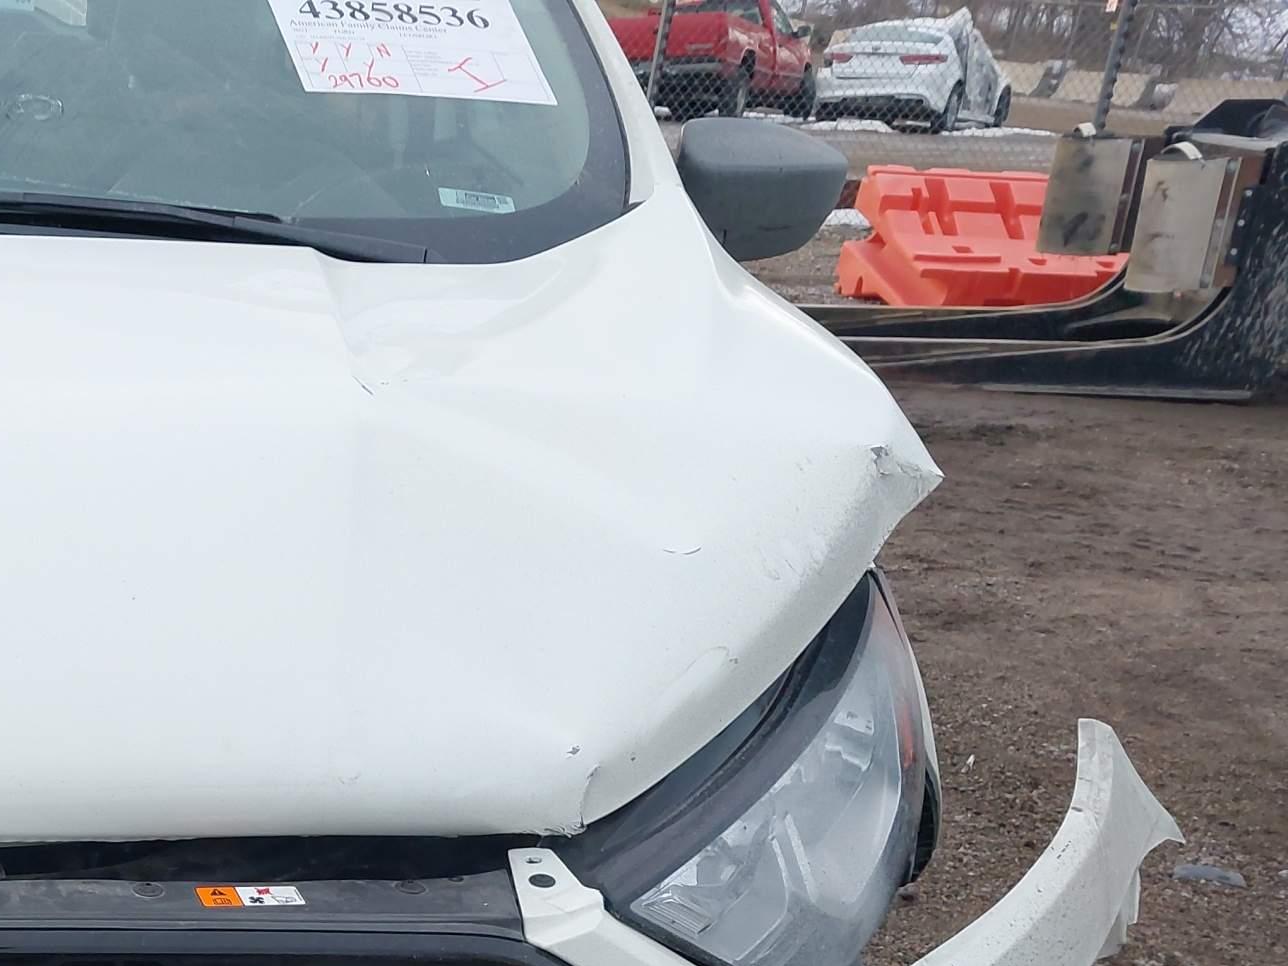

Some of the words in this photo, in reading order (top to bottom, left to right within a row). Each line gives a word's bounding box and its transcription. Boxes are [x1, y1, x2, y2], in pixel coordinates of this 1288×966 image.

[298, 0, 490, 29] 43858536
[290, 19, 338, 28] American
[340, 20, 376, 31] Family
[377, 23, 413, 31] Claims
